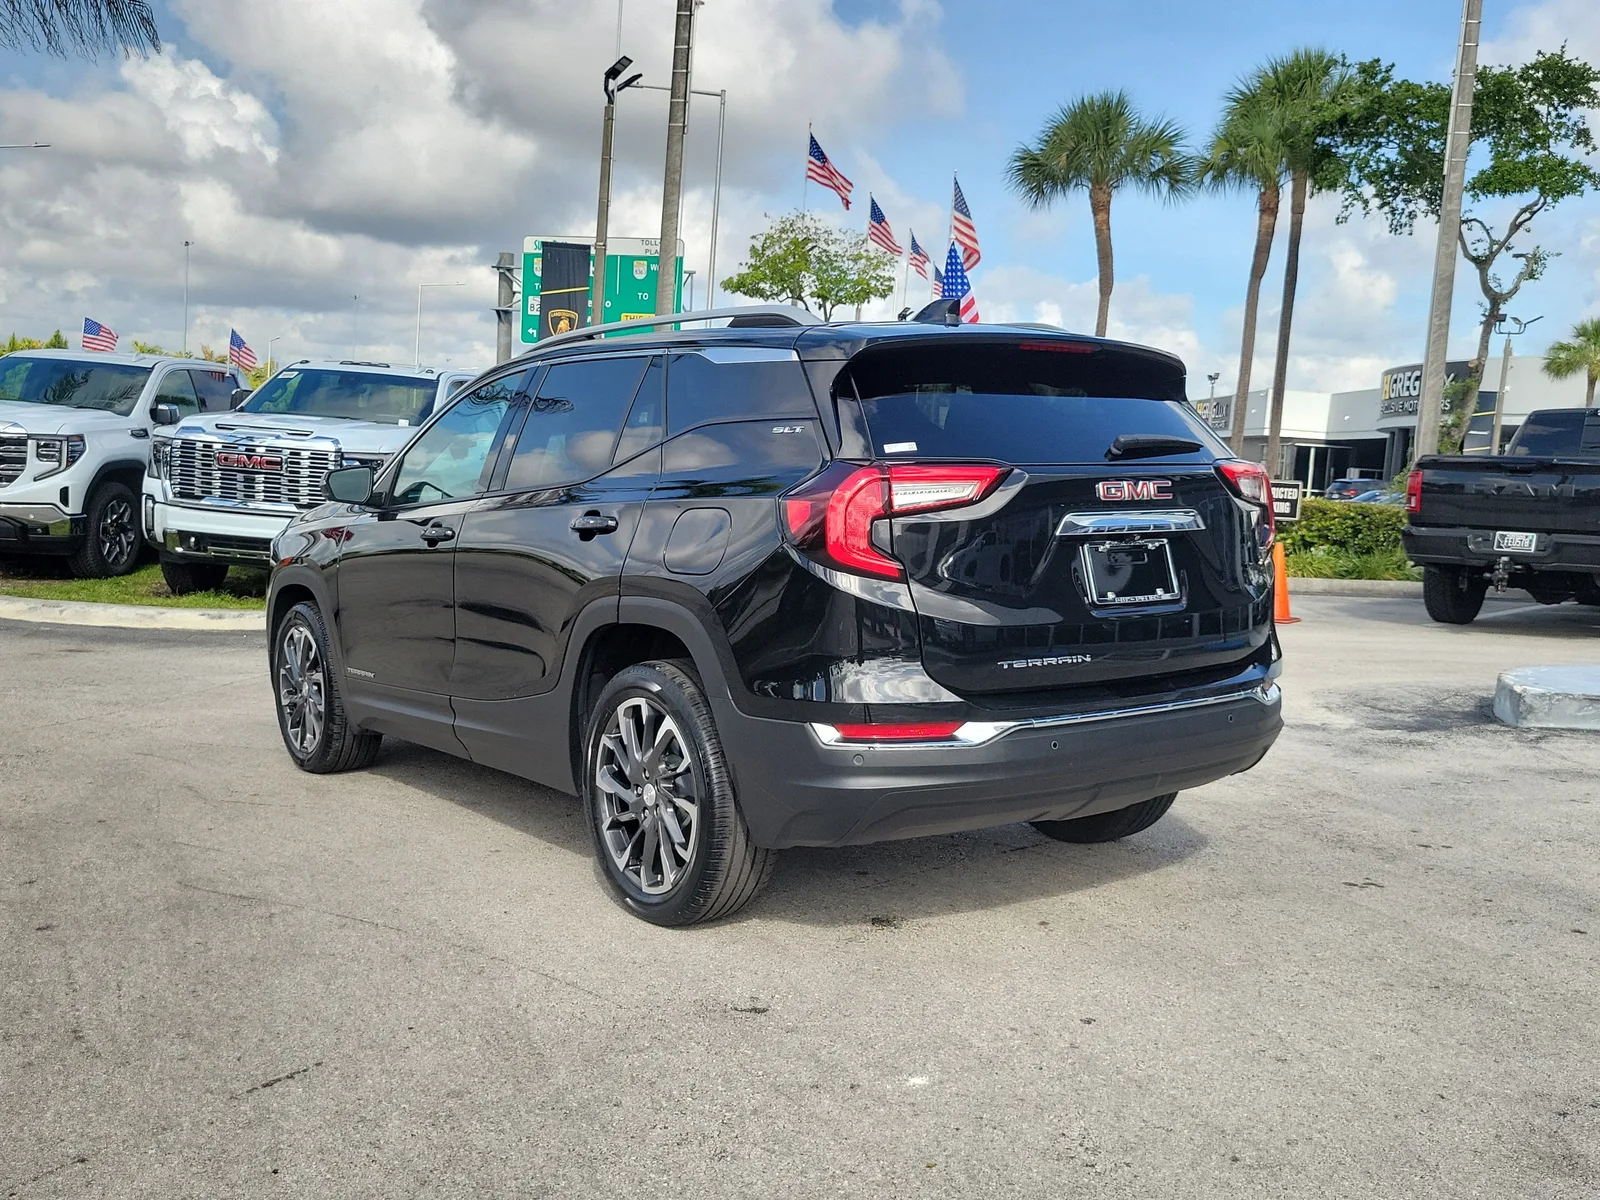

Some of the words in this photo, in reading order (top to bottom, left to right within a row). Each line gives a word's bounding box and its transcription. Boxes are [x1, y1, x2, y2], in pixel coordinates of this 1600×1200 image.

[637, 292, 649, 300] TO
[529, 303, 541, 312] 82
[771, 426, 806, 434] SLT
[218, 453, 281, 470] GMC
[1099, 480, 1173, 501] GMC
[1271, 486, 1298, 500] RICTED
[1462, 481, 1575, 497] RAM
[997, 654, 1092, 669] TERRAIN
